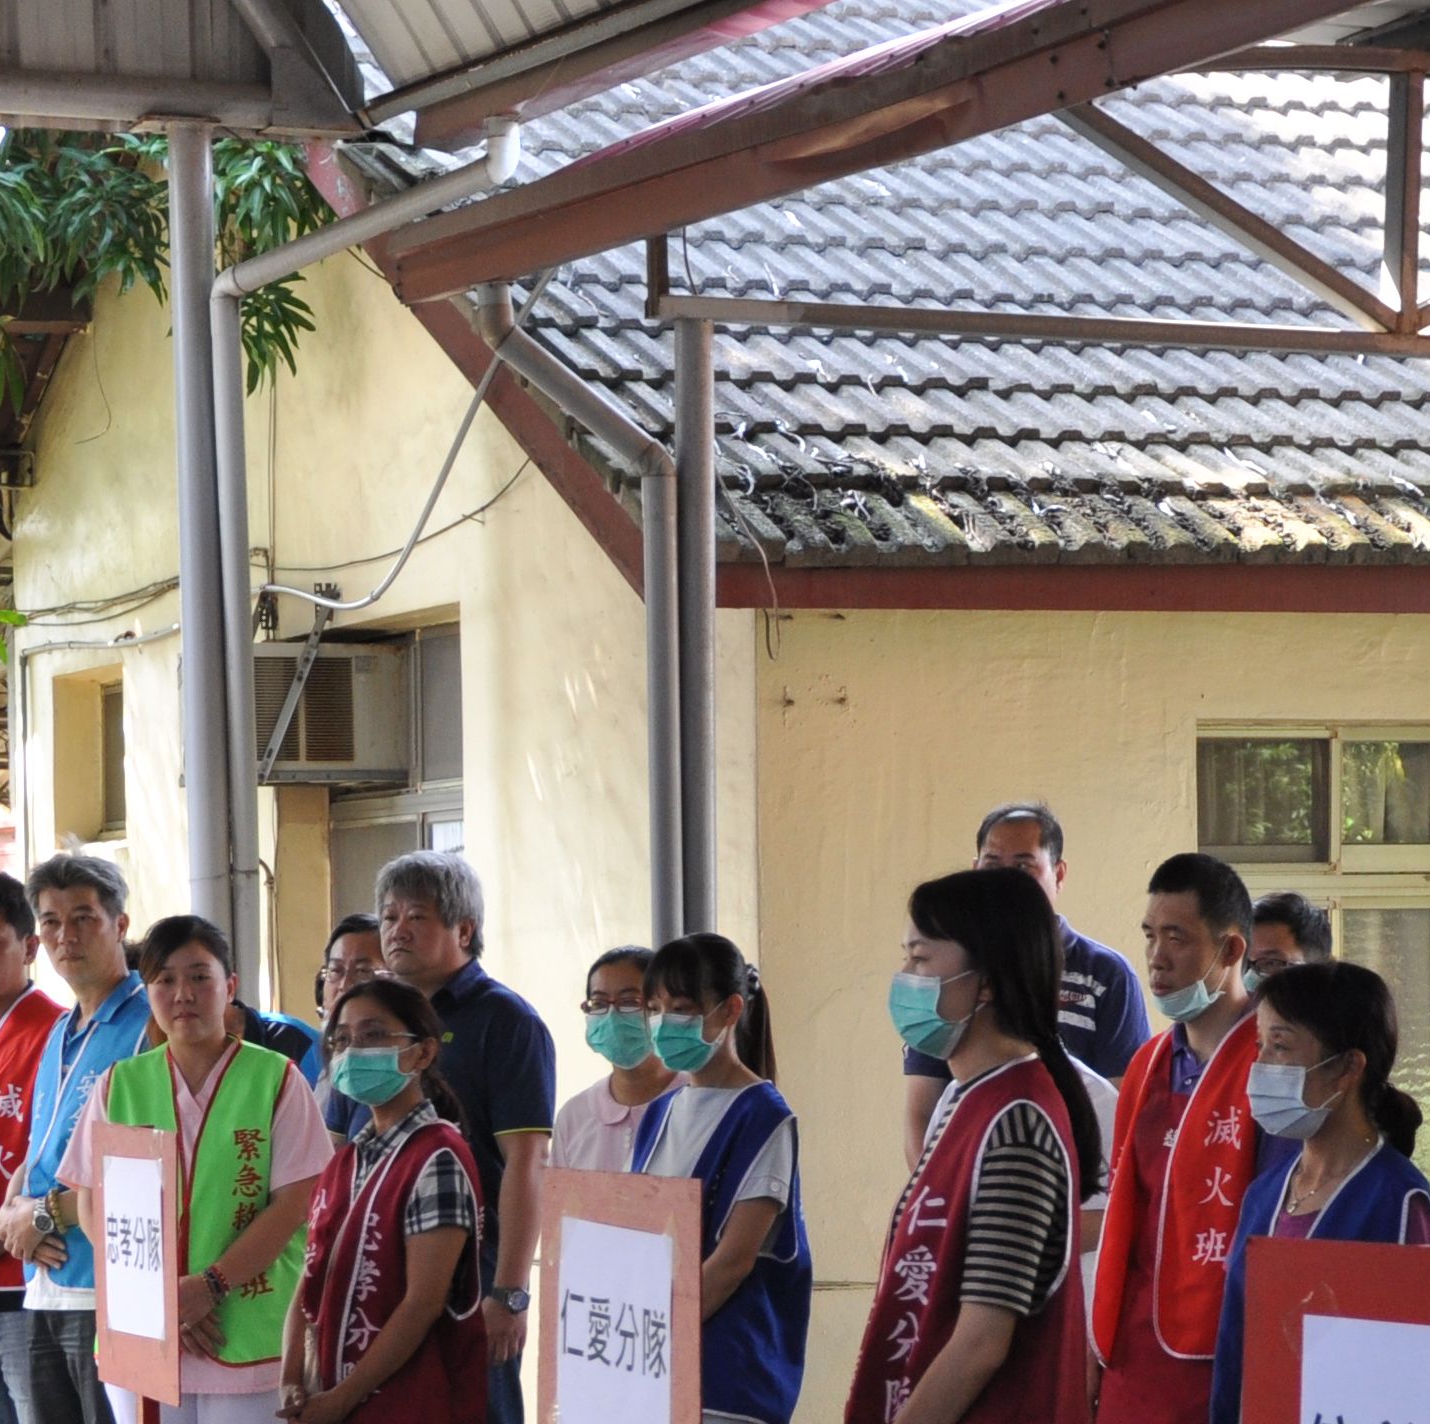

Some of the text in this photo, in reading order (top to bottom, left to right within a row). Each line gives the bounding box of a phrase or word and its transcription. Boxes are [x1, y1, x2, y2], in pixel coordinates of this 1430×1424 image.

[106, 1211, 162, 1272] 忠孝分隊
[231, 1128, 274, 1300] 緊急救班
[1192, 1105, 1243, 1266] 滅火班
[560, 1288, 668, 1379] 仁愛分隊
